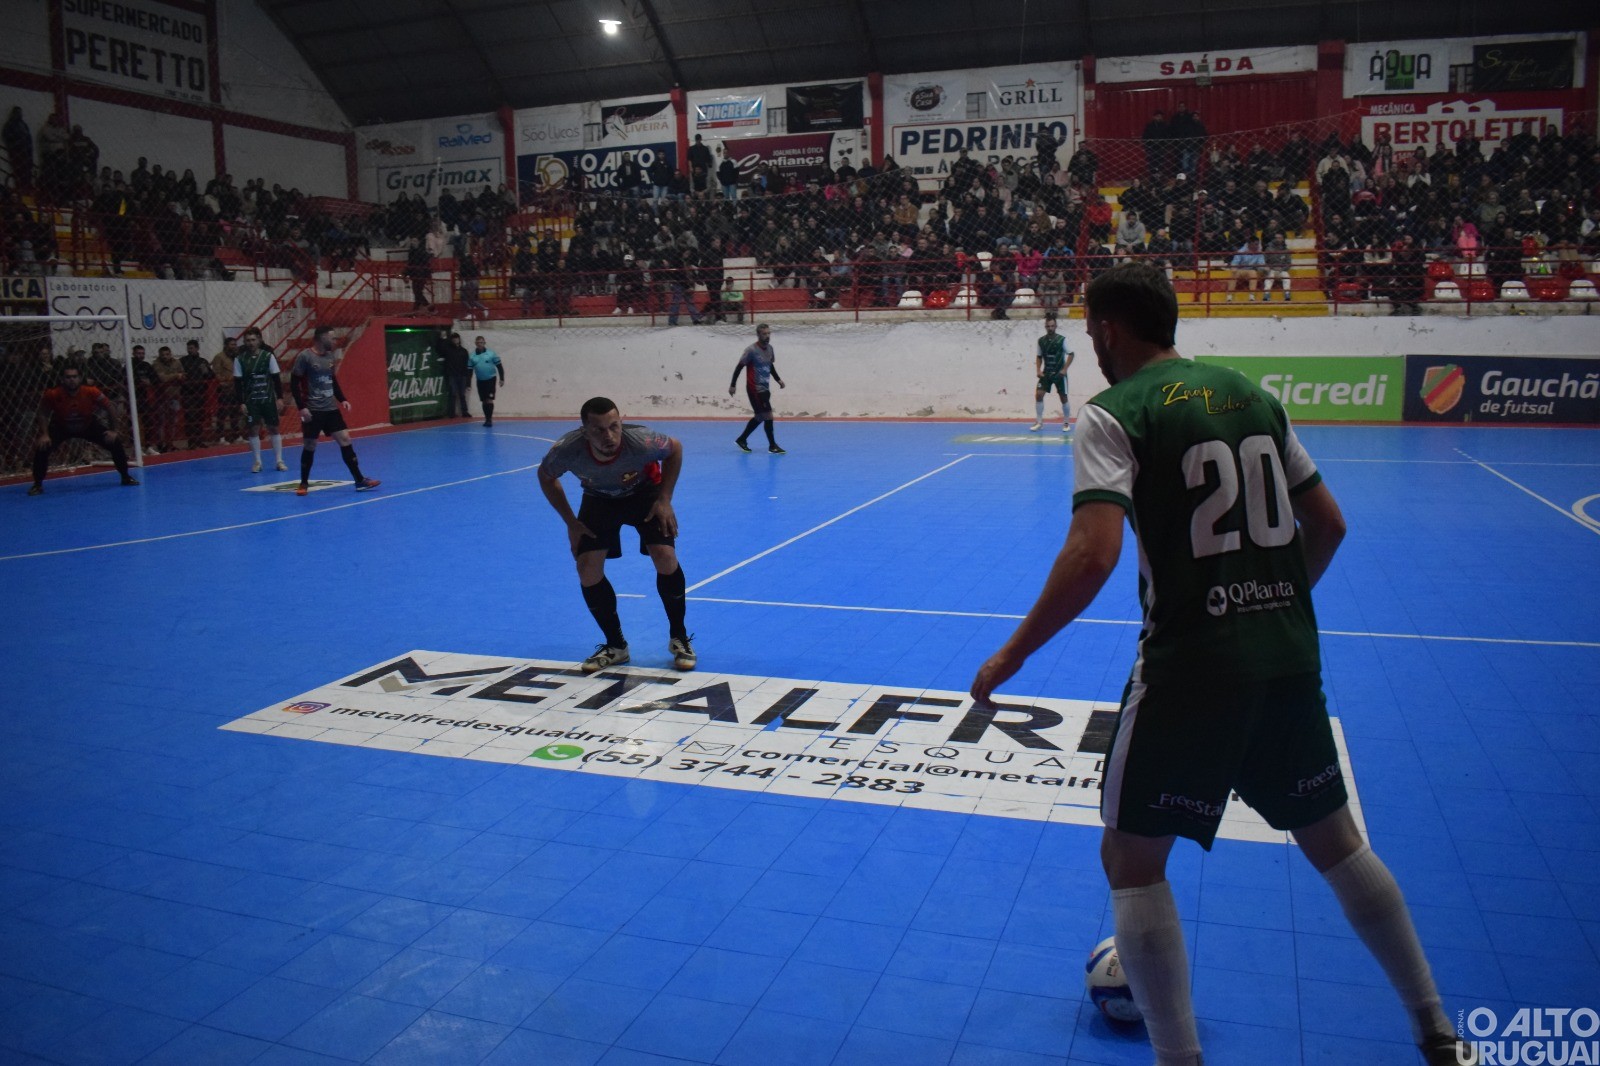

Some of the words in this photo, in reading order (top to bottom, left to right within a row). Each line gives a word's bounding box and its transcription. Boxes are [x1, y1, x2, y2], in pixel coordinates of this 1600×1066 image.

[65, 0, 202, 43] SUPERMERCADO
[66, 27, 205, 92] PERETTO
[1000, 88, 1063, 106] GRILL
[1370, 102, 1415, 115] MECÂNICA
[900, 121, 1068, 156] PEDRINHO
[1374, 116, 1548, 145] BERTOLETTI
[580, 153, 598, 172] O
[737, 153, 825, 175] Confiança
[386, 167, 493, 197] Grafimax
[572, 169, 654, 189] RUGA
[0, 278, 43, 298] ICA
[52, 295, 119, 331] São
[125, 283, 205, 331] Lucas
[387, 352, 417, 372] AQUI
[419, 346, 431, 371] É
[388, 376, 444, 400] GUARANI
[1260, 374, 1388, 405] Sicredi
[1480, 370, 1600, 399] Gauchã
[1480, 401, 1500, 413] de
[1500, 400, 1555, 417] futsal
[1181, 434, 1296, 559] 20
[1228, 580, 1295, 605] QPlanta
[330, 704, 647, 748] metalfredesquadrias
[582, 748, 663, 769] (55)
[669, 758, 774, 780] 3744
[811, 772, 926, 795] 2883
